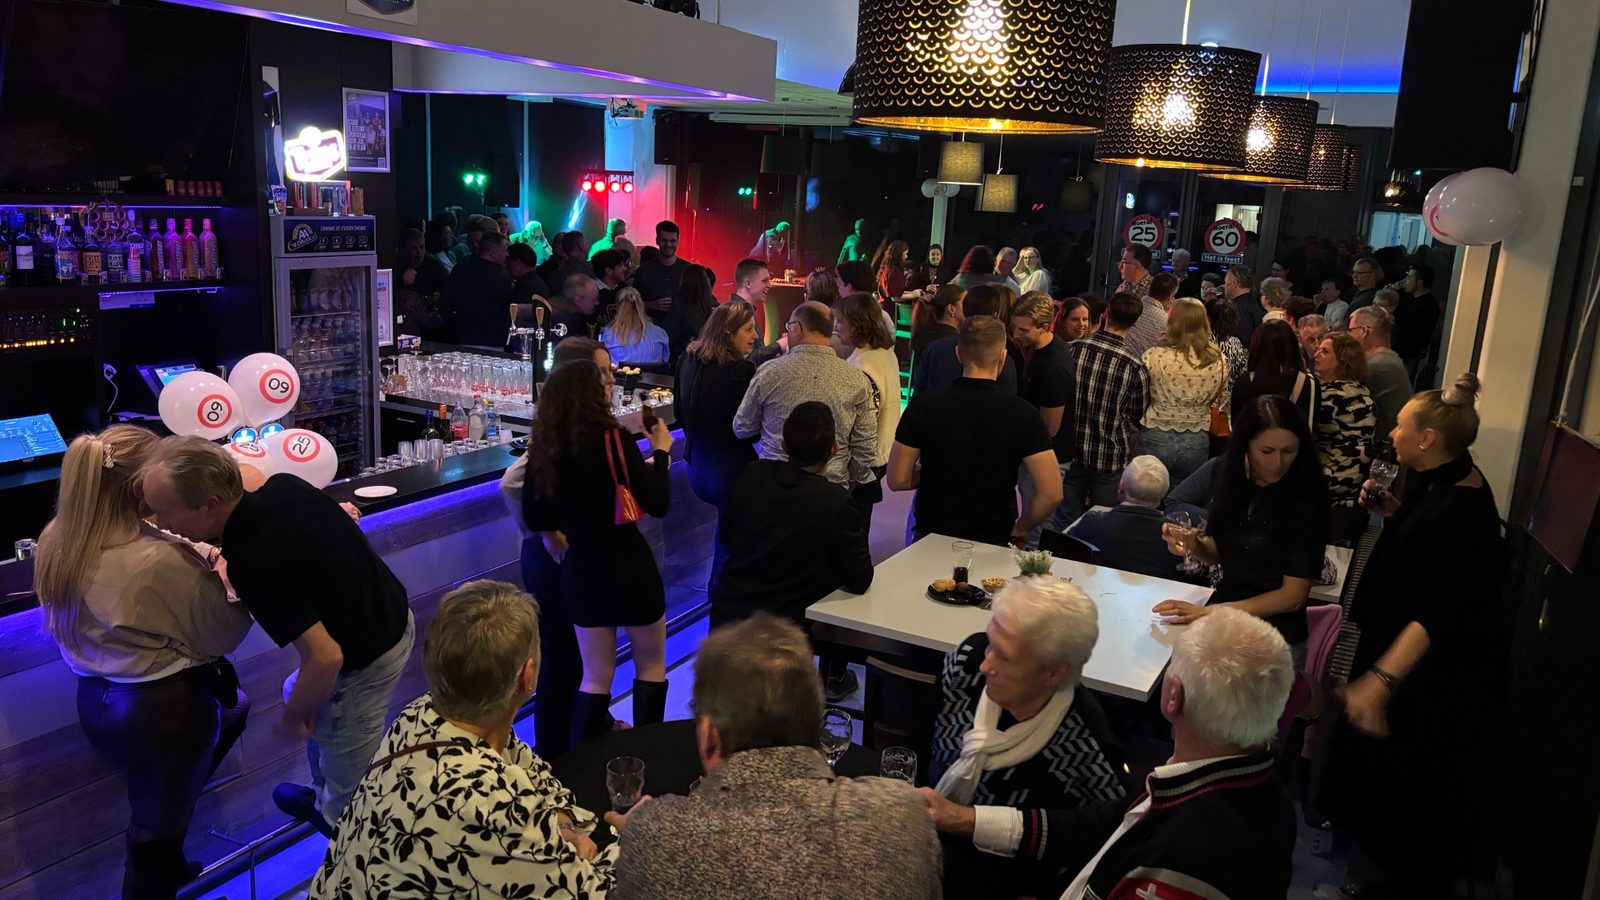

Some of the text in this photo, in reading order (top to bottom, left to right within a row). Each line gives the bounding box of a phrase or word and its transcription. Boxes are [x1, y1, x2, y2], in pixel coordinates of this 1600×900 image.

[299, 229, 310, 240] AA
[1131, 226, 1156, 243] 25
[1212, 231, 1239, 247] 60
[1224, 255, 1241, 263] feest
[268, 377, 290, 394] 60
[207, 401, 223, 422] 60
[292, 436, 311, 455] 25
